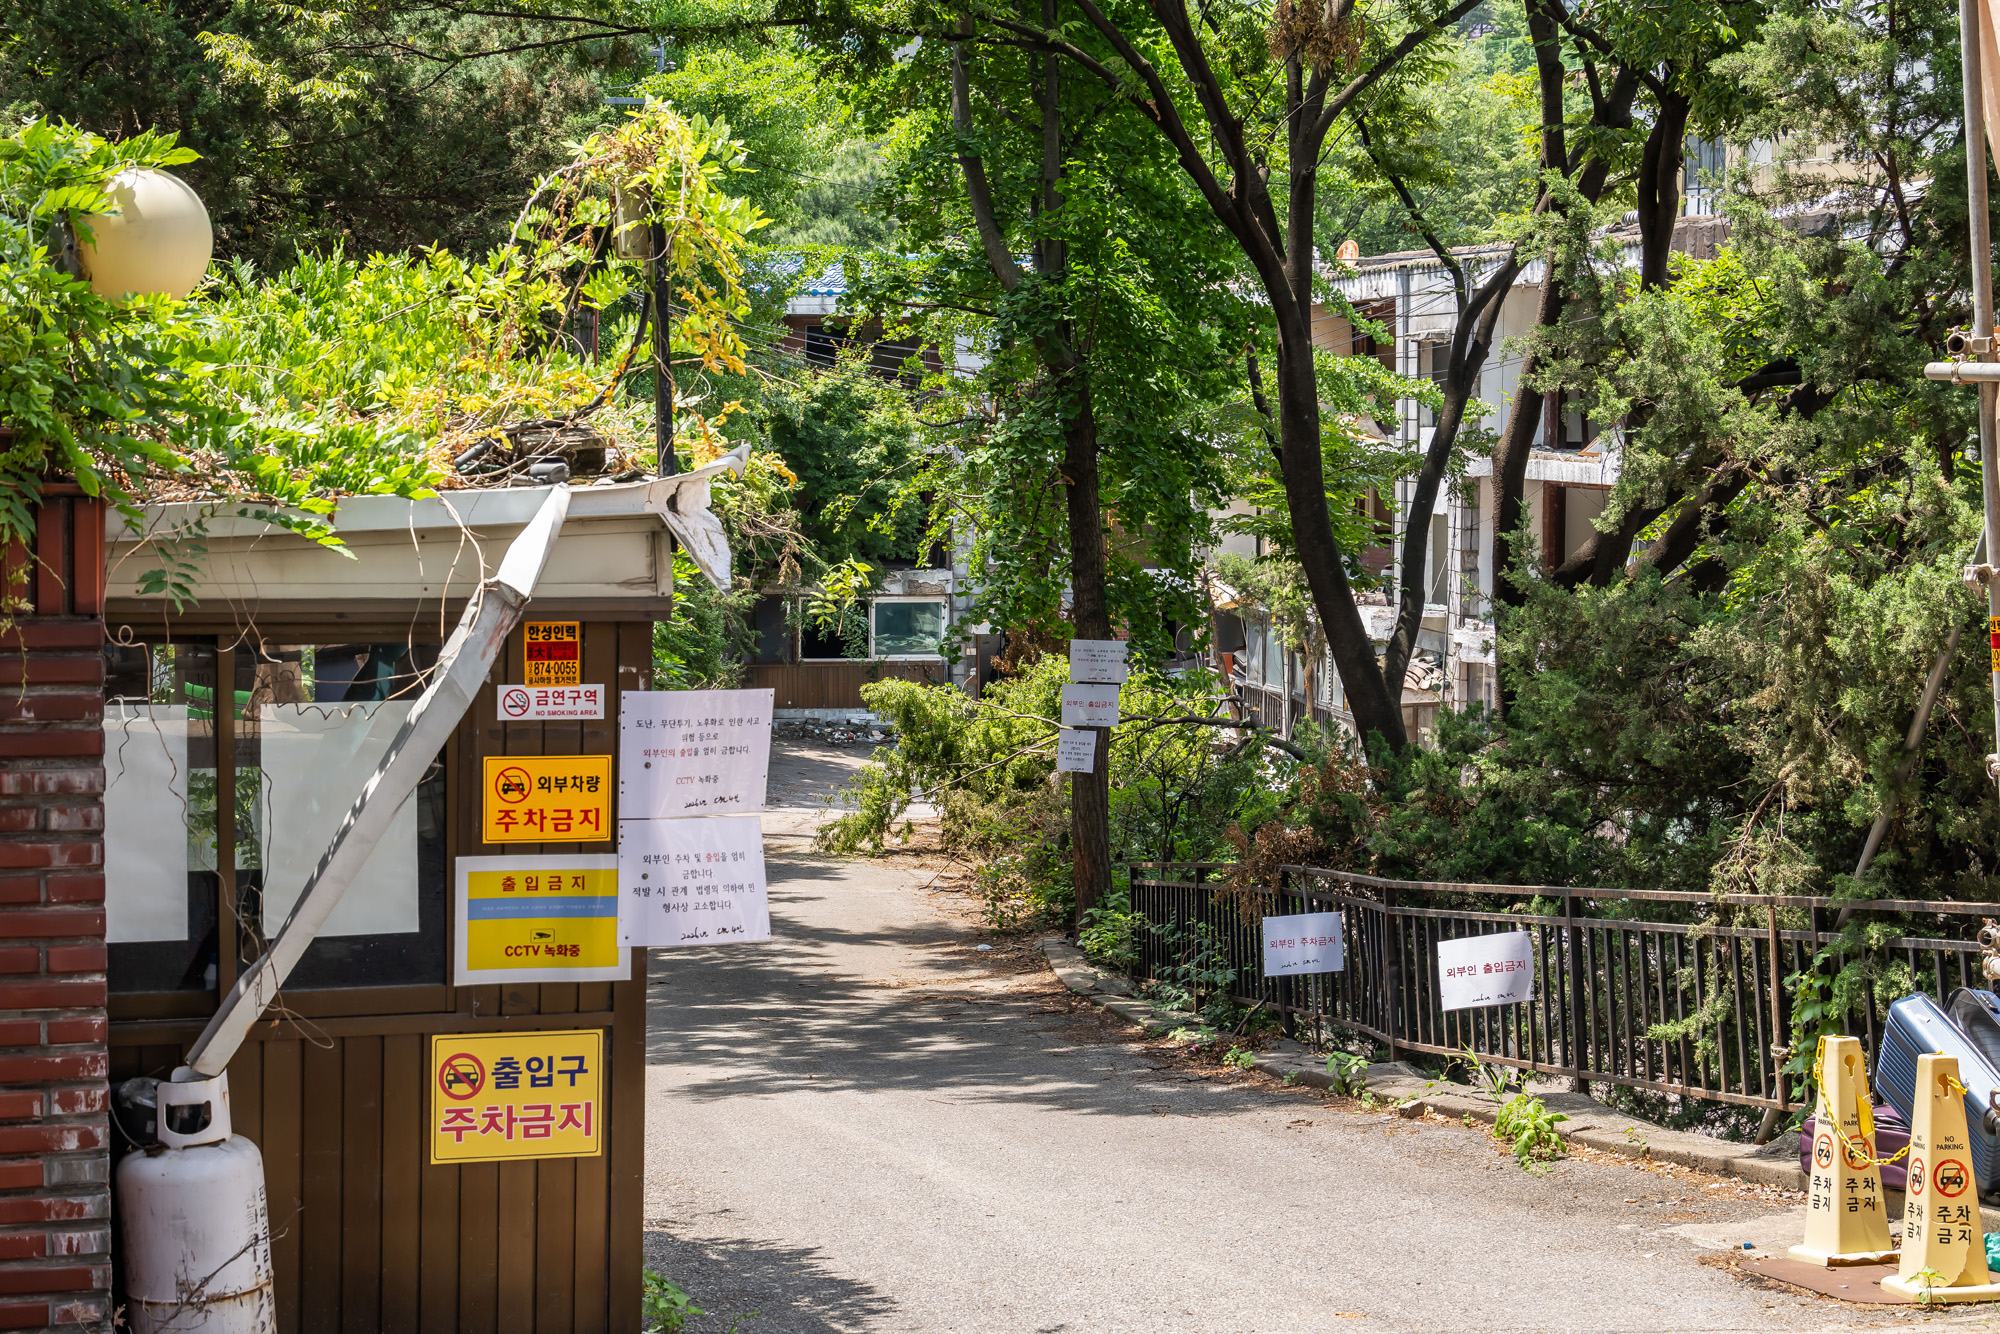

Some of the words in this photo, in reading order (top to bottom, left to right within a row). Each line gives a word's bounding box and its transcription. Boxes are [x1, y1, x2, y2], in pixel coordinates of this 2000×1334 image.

[528, 626, 576, 640] 한성인력
[535, 689, 597, 706] 금연구역
[1088, 700, 1114, 708] 출입금지
[696, 718, 725, 727] 노후화로
[728, 717, 743, 727] 인한
[746, 717, 760, 726] 사고
[681, 733, 695, 743] 위험
[643, 749, 676, 758] 외부인의
[680, 747, 699, 757] 출입을
[703, 746, 717, 756] 엄히
[537, 775, 601, 793] 외부차량
[675, 776, 695, 785] CCTV
[698, 775, 719, 784] 녹화중
[495, 807, 600, 834] 주차금지
[642, 854, 670, 865] 외부인
[675, 853, 690, 863] 주차
[694, 853, 702, 863] 및
[705, 851, 728, 863] 출입을
[731, 851, 746, 861] 엄히
[632, 886, 652, 898] 적발
[656, 886, 666, 897] 시
[671, 885, 688, 897] 관계
[695, 884, 719, 896] 법령의
[722, 883, 745, 893] 의하여
[662, 902, 689, 914] 형사상
[1269, 938, 1295, 949] 외부인
[1300, 935, 1336, 947] 주차금지
[504, 945, 541, 957] CCTV
[544, 944, 581, 957] 녹화중
[1446, 964, 1477, 978] 외부인
[1483, 959, 1526, 975] 출입금지
[491, 1055, 589, 1089] 출입구
[439, 1100, 593, 1144] 주차금지
[1917, 1134, 1922, 1142] NO
[1912, 1141, 1926, 1151] PARKING
[1936, 1143, 1964, 1151] PARKING
